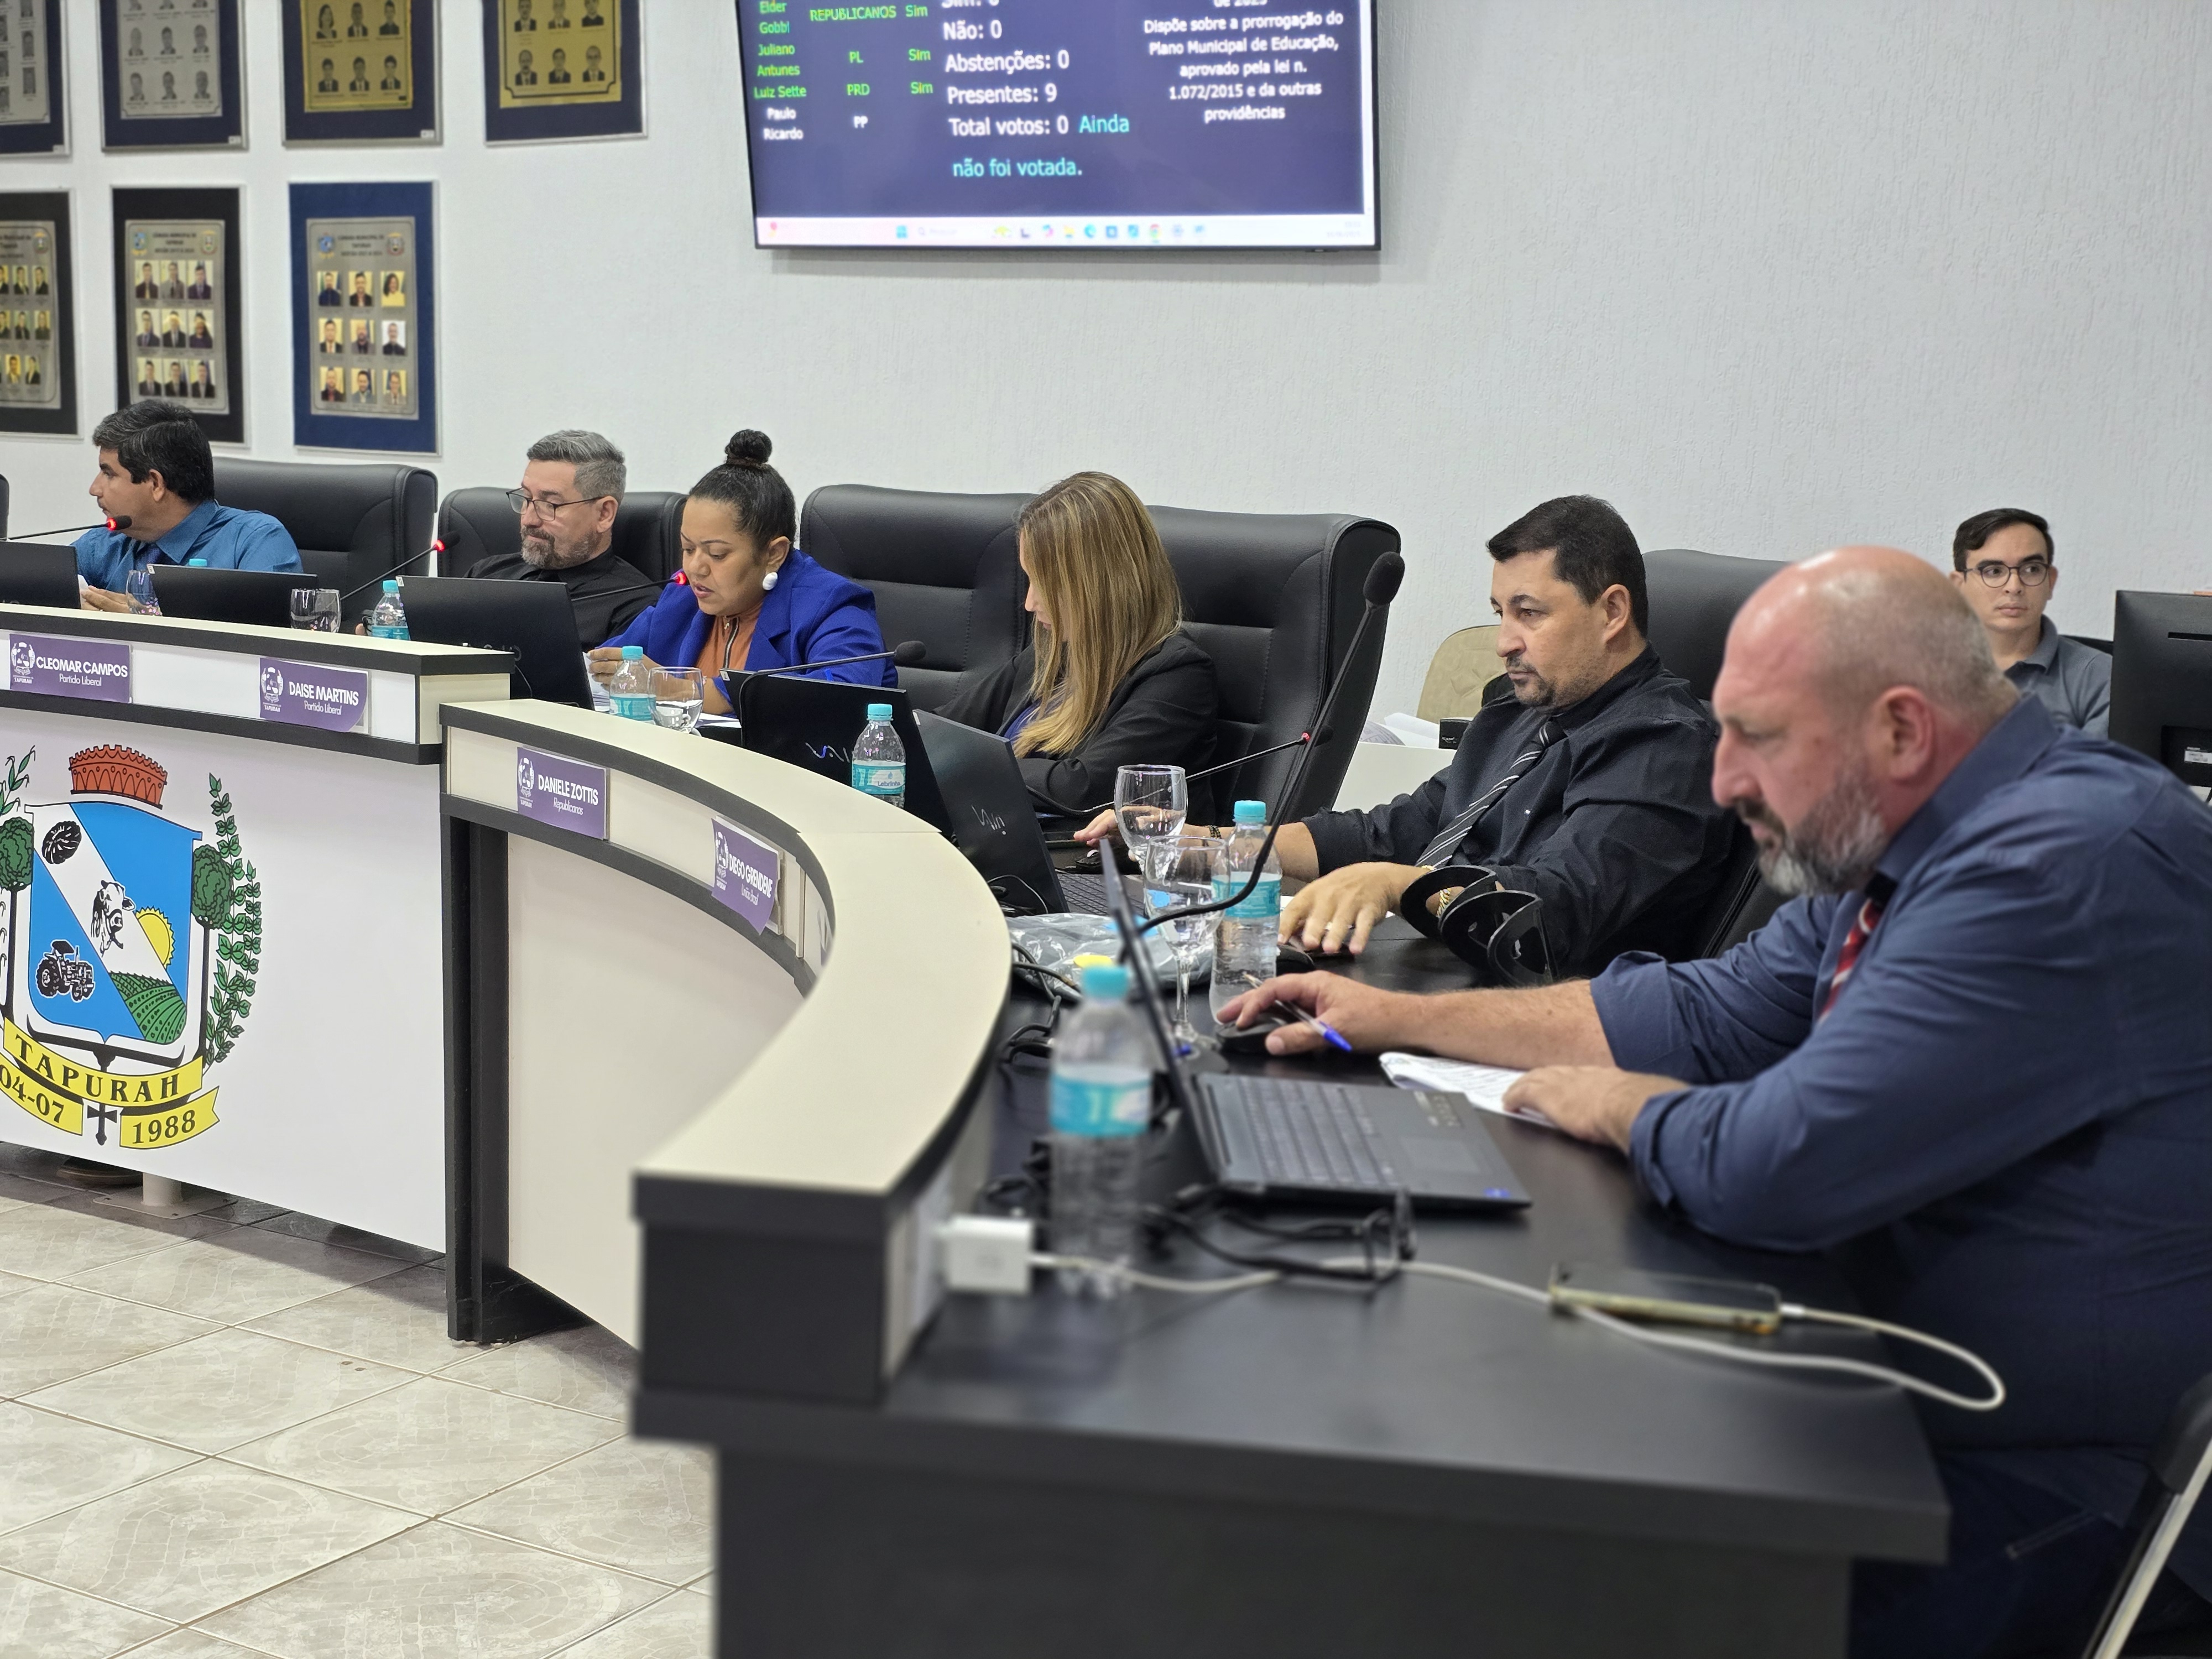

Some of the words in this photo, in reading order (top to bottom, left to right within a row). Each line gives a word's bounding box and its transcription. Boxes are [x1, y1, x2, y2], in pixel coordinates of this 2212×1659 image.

[810, 6, 897, 21] REPUBLICANOS
[905, 5, 928, 17] Sim
[759, 21, 790, 34] Gobbi
[943, 20, 984, 40] Não:
[990, 20, 1003, 39] 0
[1144, 18, 1187, 35] Dispõe
[1191, 17, 1226, 32] sobre
[1230, 18, 1238, 29] a
[1243, 12, 1322, 32] prorrogação
[1326, 11, 1344, 25] do
[758, 44, 795, 56] Juliano
[1149, 41, 1184, 55] Plano
[1187, 38, 1247, 55] Municipal
[1250, 38, 1267, 51] de
[1271, 34, 1338, 52] Educação,
[849, 51, 863, 63] PL
[909, 49, 931, 61] Sim
[945, 50, 1051, 75] Abstenções:
[1057, 49, 1070, 69] 0
[757, 65, 800, 76] Antunes
[1180, 61, 1239, 79] aprovado
[1243, 59, 1270, 77] pela
[1274, 59, 1290, 73] lei
[1294, 60, 1307, 73] n.
[754, 87, 775, 98] Luiz
[778, 86, 807, 98] Sette
[847, 84, 870, 96] PRD
[911, 81, 933, 94] Sim
[947, 86, 1039, 105] Presentes:
[1045, 83, 1057, 102] 9
[1169, 84, 1243, 101] 1.072/2015
[1246, 86, 1255, 97] e
[1259, 83, 1275, 97] da
[1279, 82, 1322, 96] outras
[766, 107, 796, 119] Paulo
[853, 116, 868, 128] PP
[1204, 105, 1285, 124] providências
[763, 127, 804, 140] Ricardo
[948, 117, 990, 136] Total
[996, 117, 1050, 135] votos:
[1056, 114, 1069, 134] 0
[1079, 113, 1130, 133] Ainda
[953, 158, 984, 177] não
[989, 158, 1011, 176] foi
[1016, 157, 1082, 176] votada.
[36, 656, 82, 673] CLEOMAR
[83, 661, 128, 678] CAMPOS
[59, 673, 81, 685] Partido
[82, 675, 102, 687] Liberal
[289, 681, 315, 700] DAISE
[316, 686, 358, 706] MARTINS
[304, 700, 324, 713] Partido
[325, 703, 342, 715] Liberal
[538, 774, 570, 797] DANIELE
[570, 782, 599, 806] ZOTTIS
[554, 797, 583, 816] Republicanos
[729, 853, 745, 880] DIEGO
[745, 864, 773, 899] GRENDENE
[15, 1034, 180, 1103] TAPURAH
[0, 1063, 65, 1124] 04-07
[132, 1110, 196, 1144] 1988
